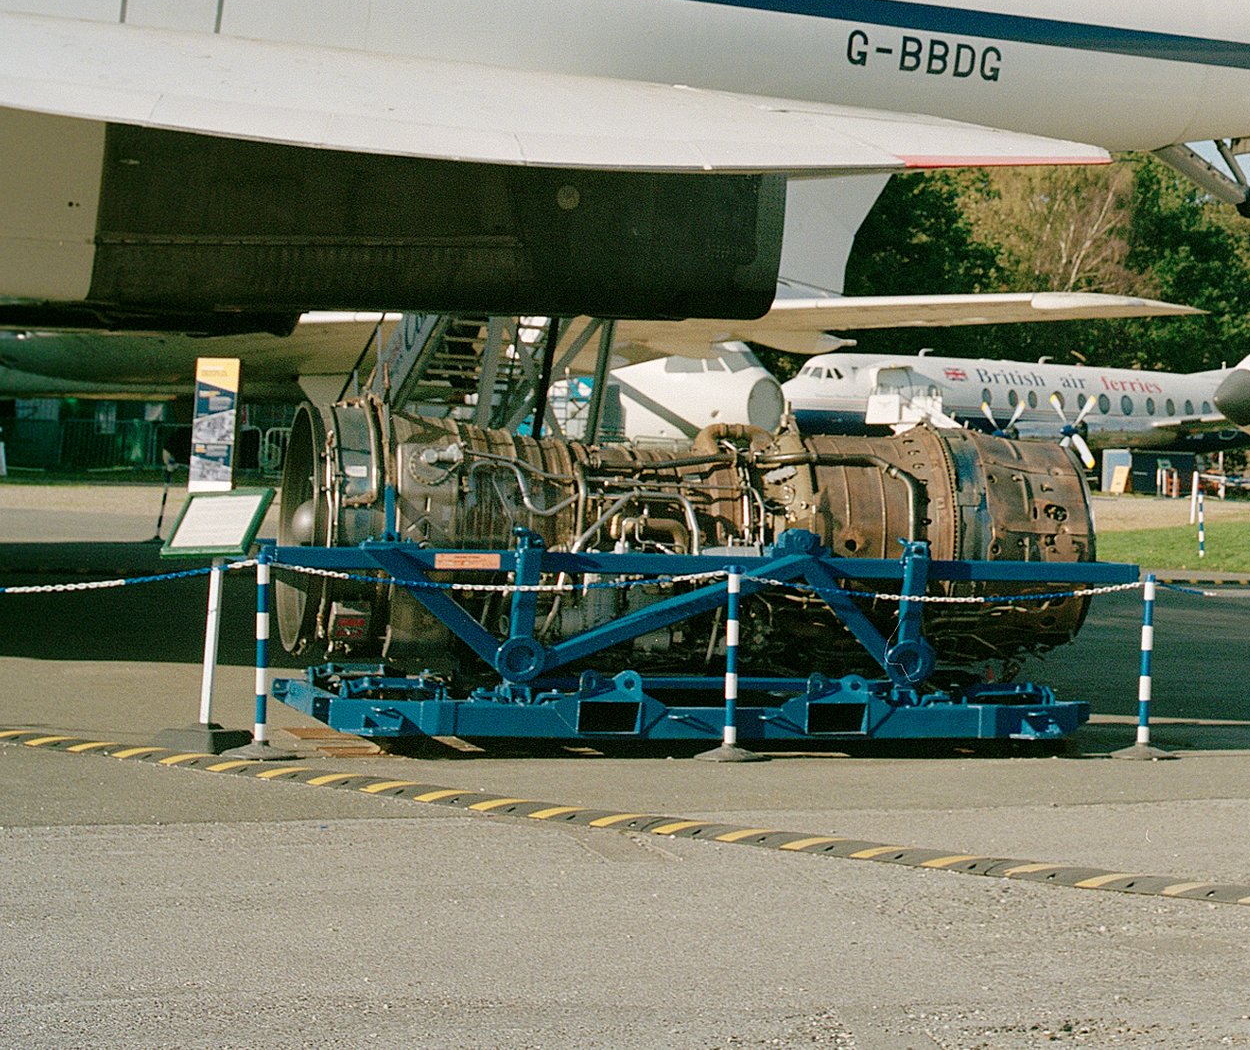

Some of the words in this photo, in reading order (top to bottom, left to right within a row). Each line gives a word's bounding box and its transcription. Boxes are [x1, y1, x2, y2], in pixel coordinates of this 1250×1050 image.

[846, 29, 1002, 82] G-BBDG
[976, 368, 1046, 387] British
[1060, 374, 1087, 389] air
[1101, 376, 1163, 394] ferries
